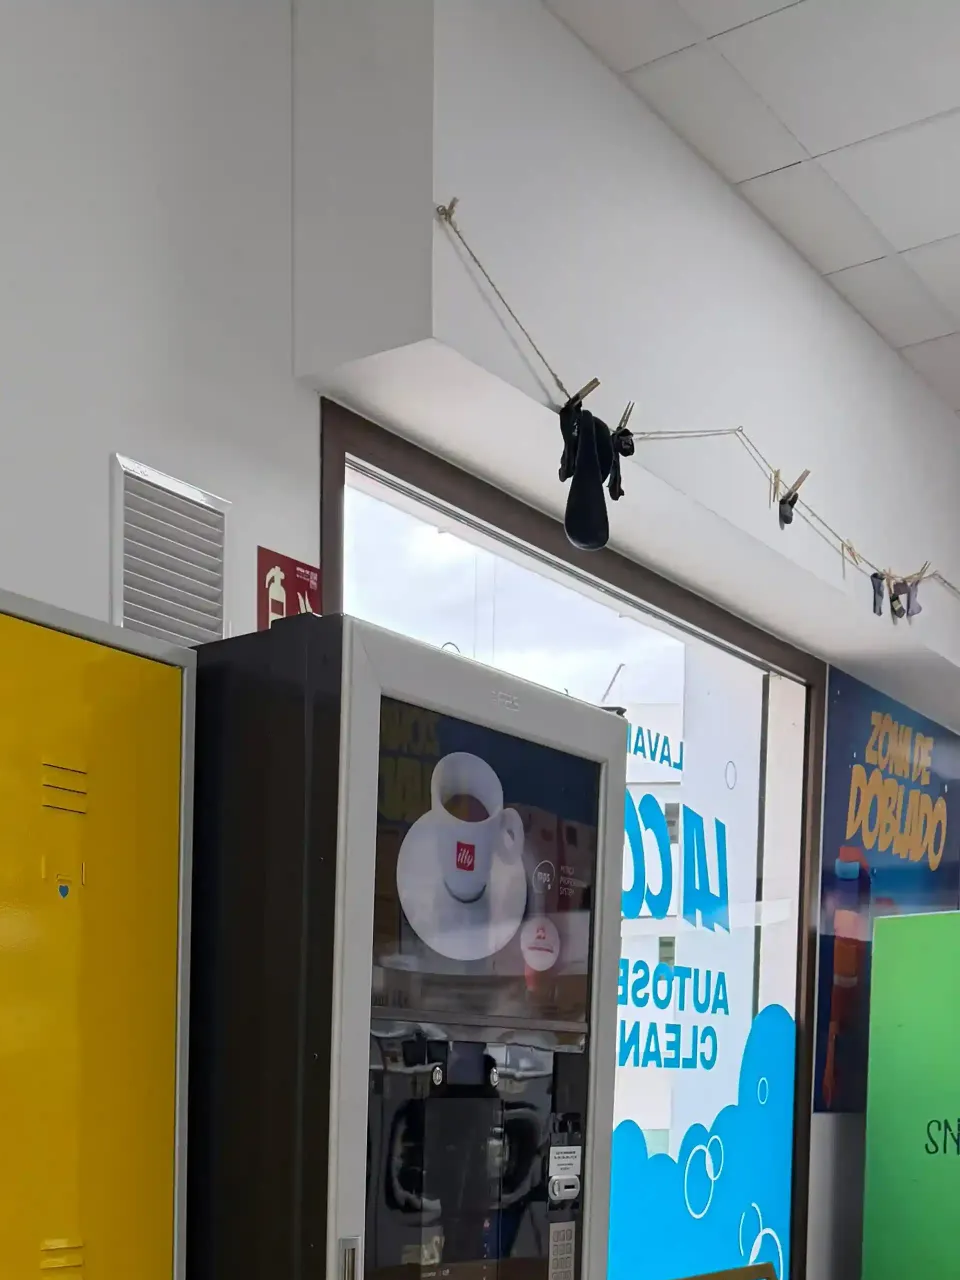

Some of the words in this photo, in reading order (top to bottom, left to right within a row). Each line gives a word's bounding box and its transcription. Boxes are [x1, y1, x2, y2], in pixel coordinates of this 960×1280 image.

[865, 711, 912, 779] ZONA
[912, 732, 934, 786] DE
[846, 764, 947, 871] DOBLADO
[457, 848, 474, 867] illy
